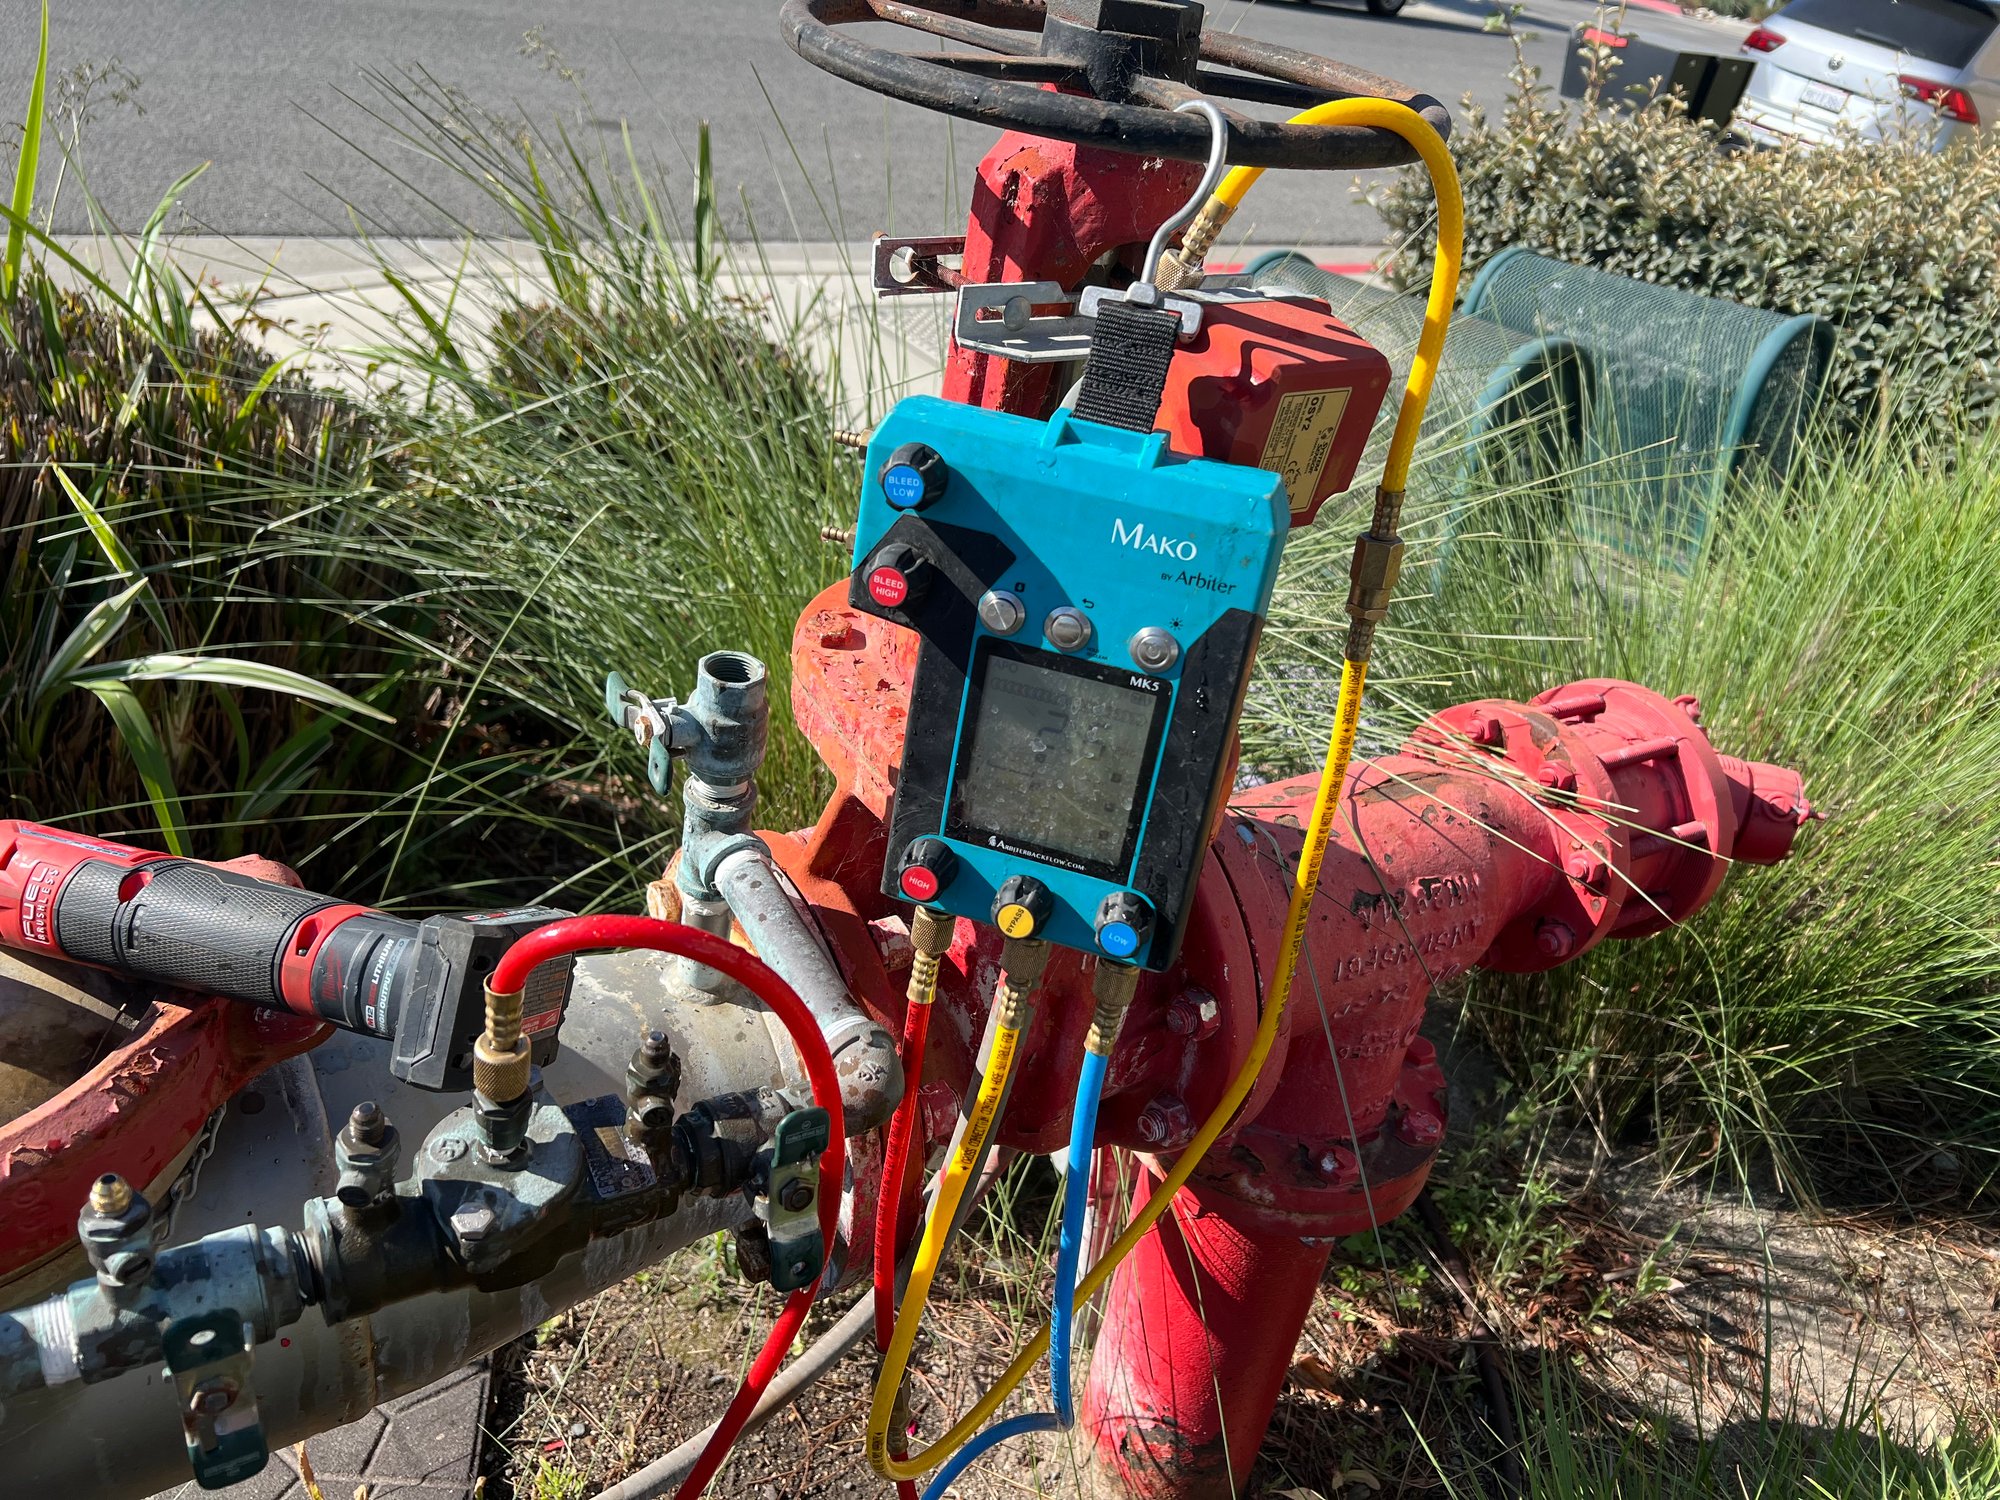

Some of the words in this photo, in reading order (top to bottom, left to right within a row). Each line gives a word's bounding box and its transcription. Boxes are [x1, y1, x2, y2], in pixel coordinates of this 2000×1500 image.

[1301, 397, 1319, 432] OSY2
[888, 476, 920, 487] BLEED
[893, 488, 915, 497] LOW
[1111, 518, 1198, 561] MAKO
[873, 575, 904, 589] BLEED
[875, 586, 898, 599] HIGH
[1161, 572, 1173, 582] BY
[1175, 571, 1237, 595] Arbiter
[1129, 676, 1160, 692] MK5
[1342, 699, 1357, 725] PRESSURE
[908, 876, 930, 890] HIGH
[23, 866, 49, 938] FUEL
[35, 868, 60, 941] BRUSHLESS
[1006, 908, 1025, 934] BYPASS
[1108, 932, 1130, 947] LOW
[380, 970, 393, 1009] OUTPUT
[366, 1006, 376, 1027] M12
[378, 1010, 389, 1032] HIGH
[962, 1149, 977, 1165] CROSS
[991, 1072, 1005, 1086] HOSE
[1001, 1032, 1014, 1044] FOR
